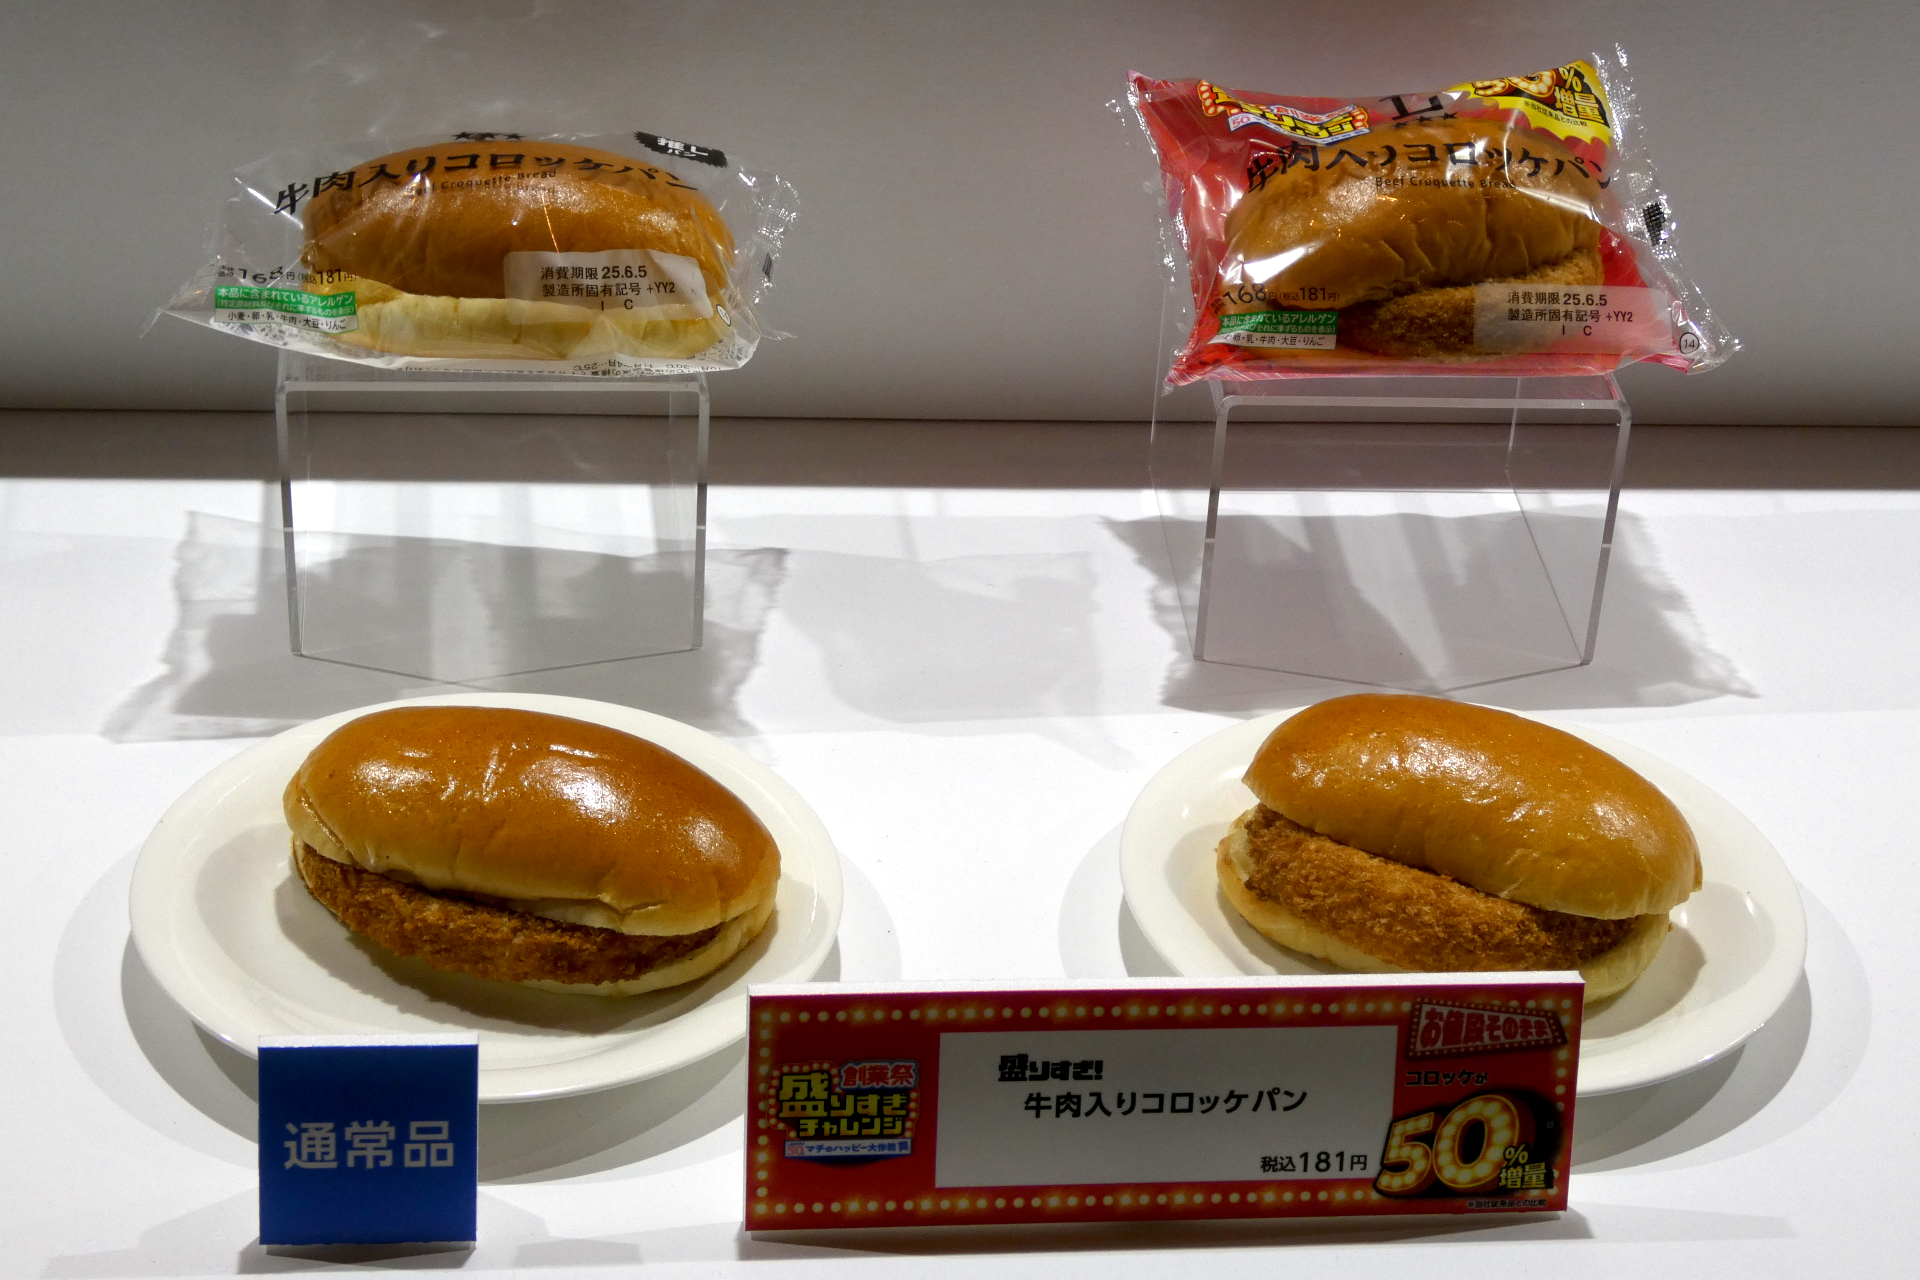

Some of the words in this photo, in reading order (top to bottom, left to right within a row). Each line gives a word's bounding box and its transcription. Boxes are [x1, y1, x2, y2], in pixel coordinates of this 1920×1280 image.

[1554, 86, 1605, 124] 増量
[274, 153, 699, 215] 牛肉入りコロッケパン
[441, 175, 511, 190] Croquette
[517, 169, 557, 180] Bread
[1375, 176, 1405, 187] Beef
[1409, 176, 1475, 188] Croquette
[1480, 179, 1516, 189] Bread
[541, 266, 599, 280] 消費期限
[601, 265, 648, 279] 25.6.5
[218, 287, 353, 307] 本品に含まれているアレルゲン
[542, 282, 641, 298] 製造所固有記号
[646, 281, 676, 295] +YY2
[1507, 291, 1561, 305] 消費期限
[1563, 293, 1608, 306] 25.6.5
[1507, 308, 1601, 322] 製造所固有記号
[1606, 310, 1633, 322] +YY2
[1683, 338, 1695, 349] 14
[1420, 1007, 1549, 1049] お値段そのまま
[842, 1063, 915, 1087] 創業祭
[1405, 1070, 1489, 1086] コロッケが
[779, 1072, 908, 1117] 盛りすぎ
[1024, 1087, 1308, 1119] 牛肉入りコロッケパン
[799, 1117, 903, 1137] チャレンジ
[284, 1120, 454, 1170] 通常品
[1260, 1150, 1368, 1173] 税込181円
[1499, 1161, 1547, 1190] 増量
